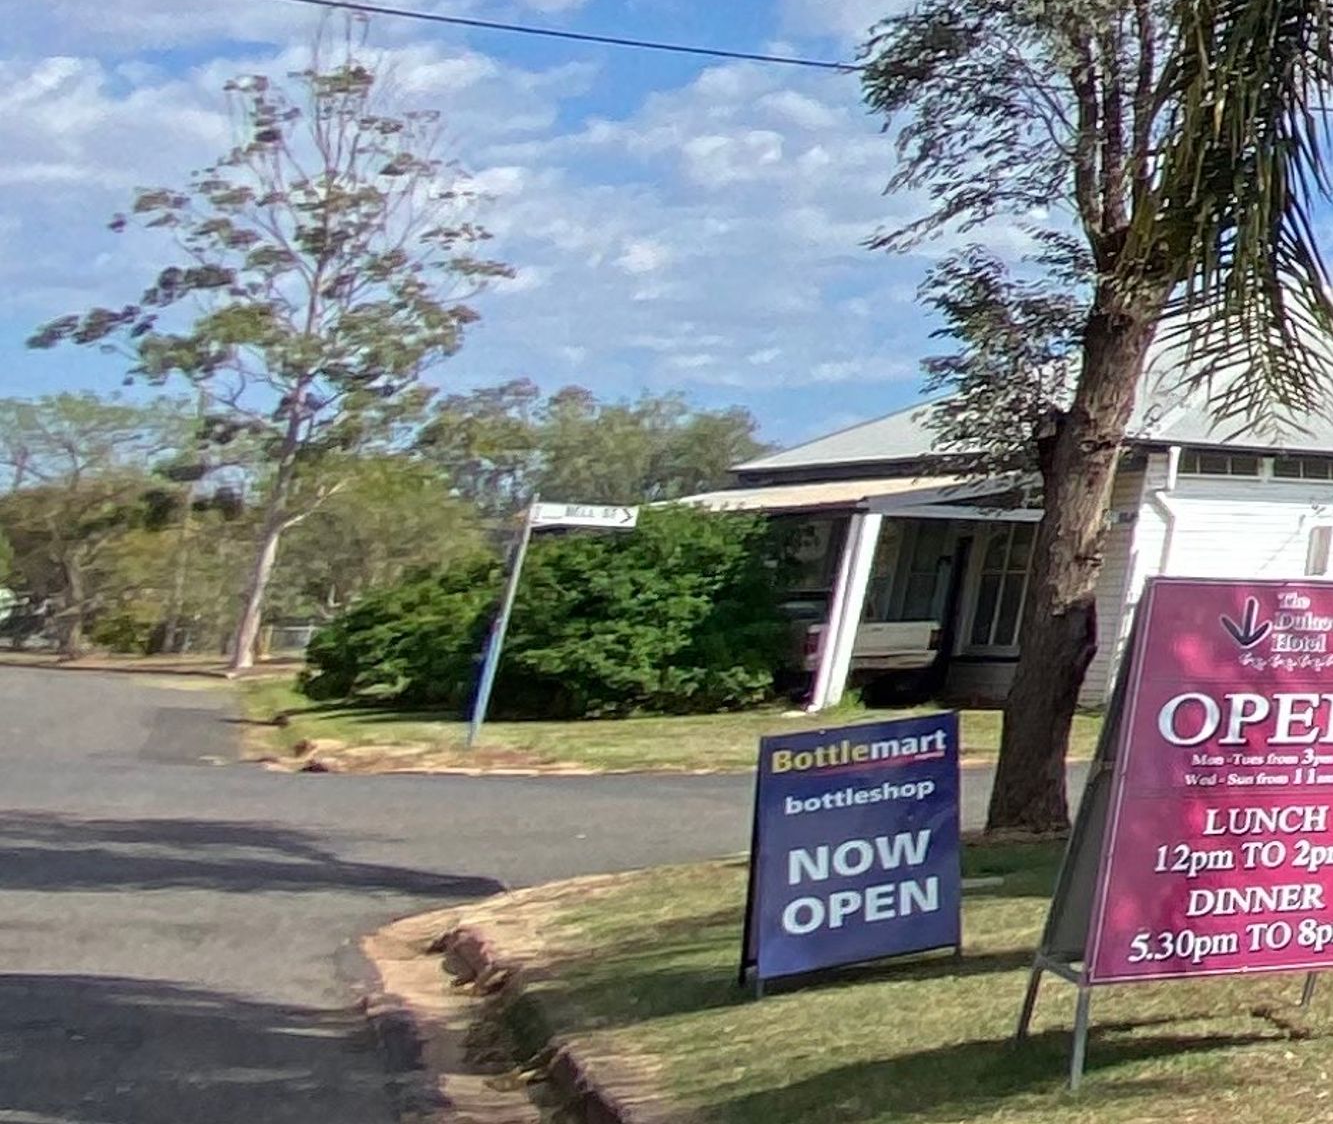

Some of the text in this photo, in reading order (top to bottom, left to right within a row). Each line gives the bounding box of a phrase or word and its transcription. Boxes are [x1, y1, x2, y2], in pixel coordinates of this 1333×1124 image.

[1271, 633, 1326, 652] Hotel
[771, 729, 947, 774] Bottlemart
[1266, 753, 1298, 766] from
[785, 779, 935, 815] bottleshop
[1185, 774, 1218, 786] Wed
[1227, 773, 1253, 786] Sun
[1256, 773, 1288, 785] from
[1203, 805, 1329, 836] LUNCH
[788, 829, 931, 885] NOW
[1155, 844, 1234, 878] 12pm
[1241, 841, 1286, 869] TO
[783, 876, 939, 935] OPEN
[1186, 883, 1326, 917] DINNER
[1128, 930, 1239, 963] 5.30pm
[1246, 921, 1292, 952] TO
